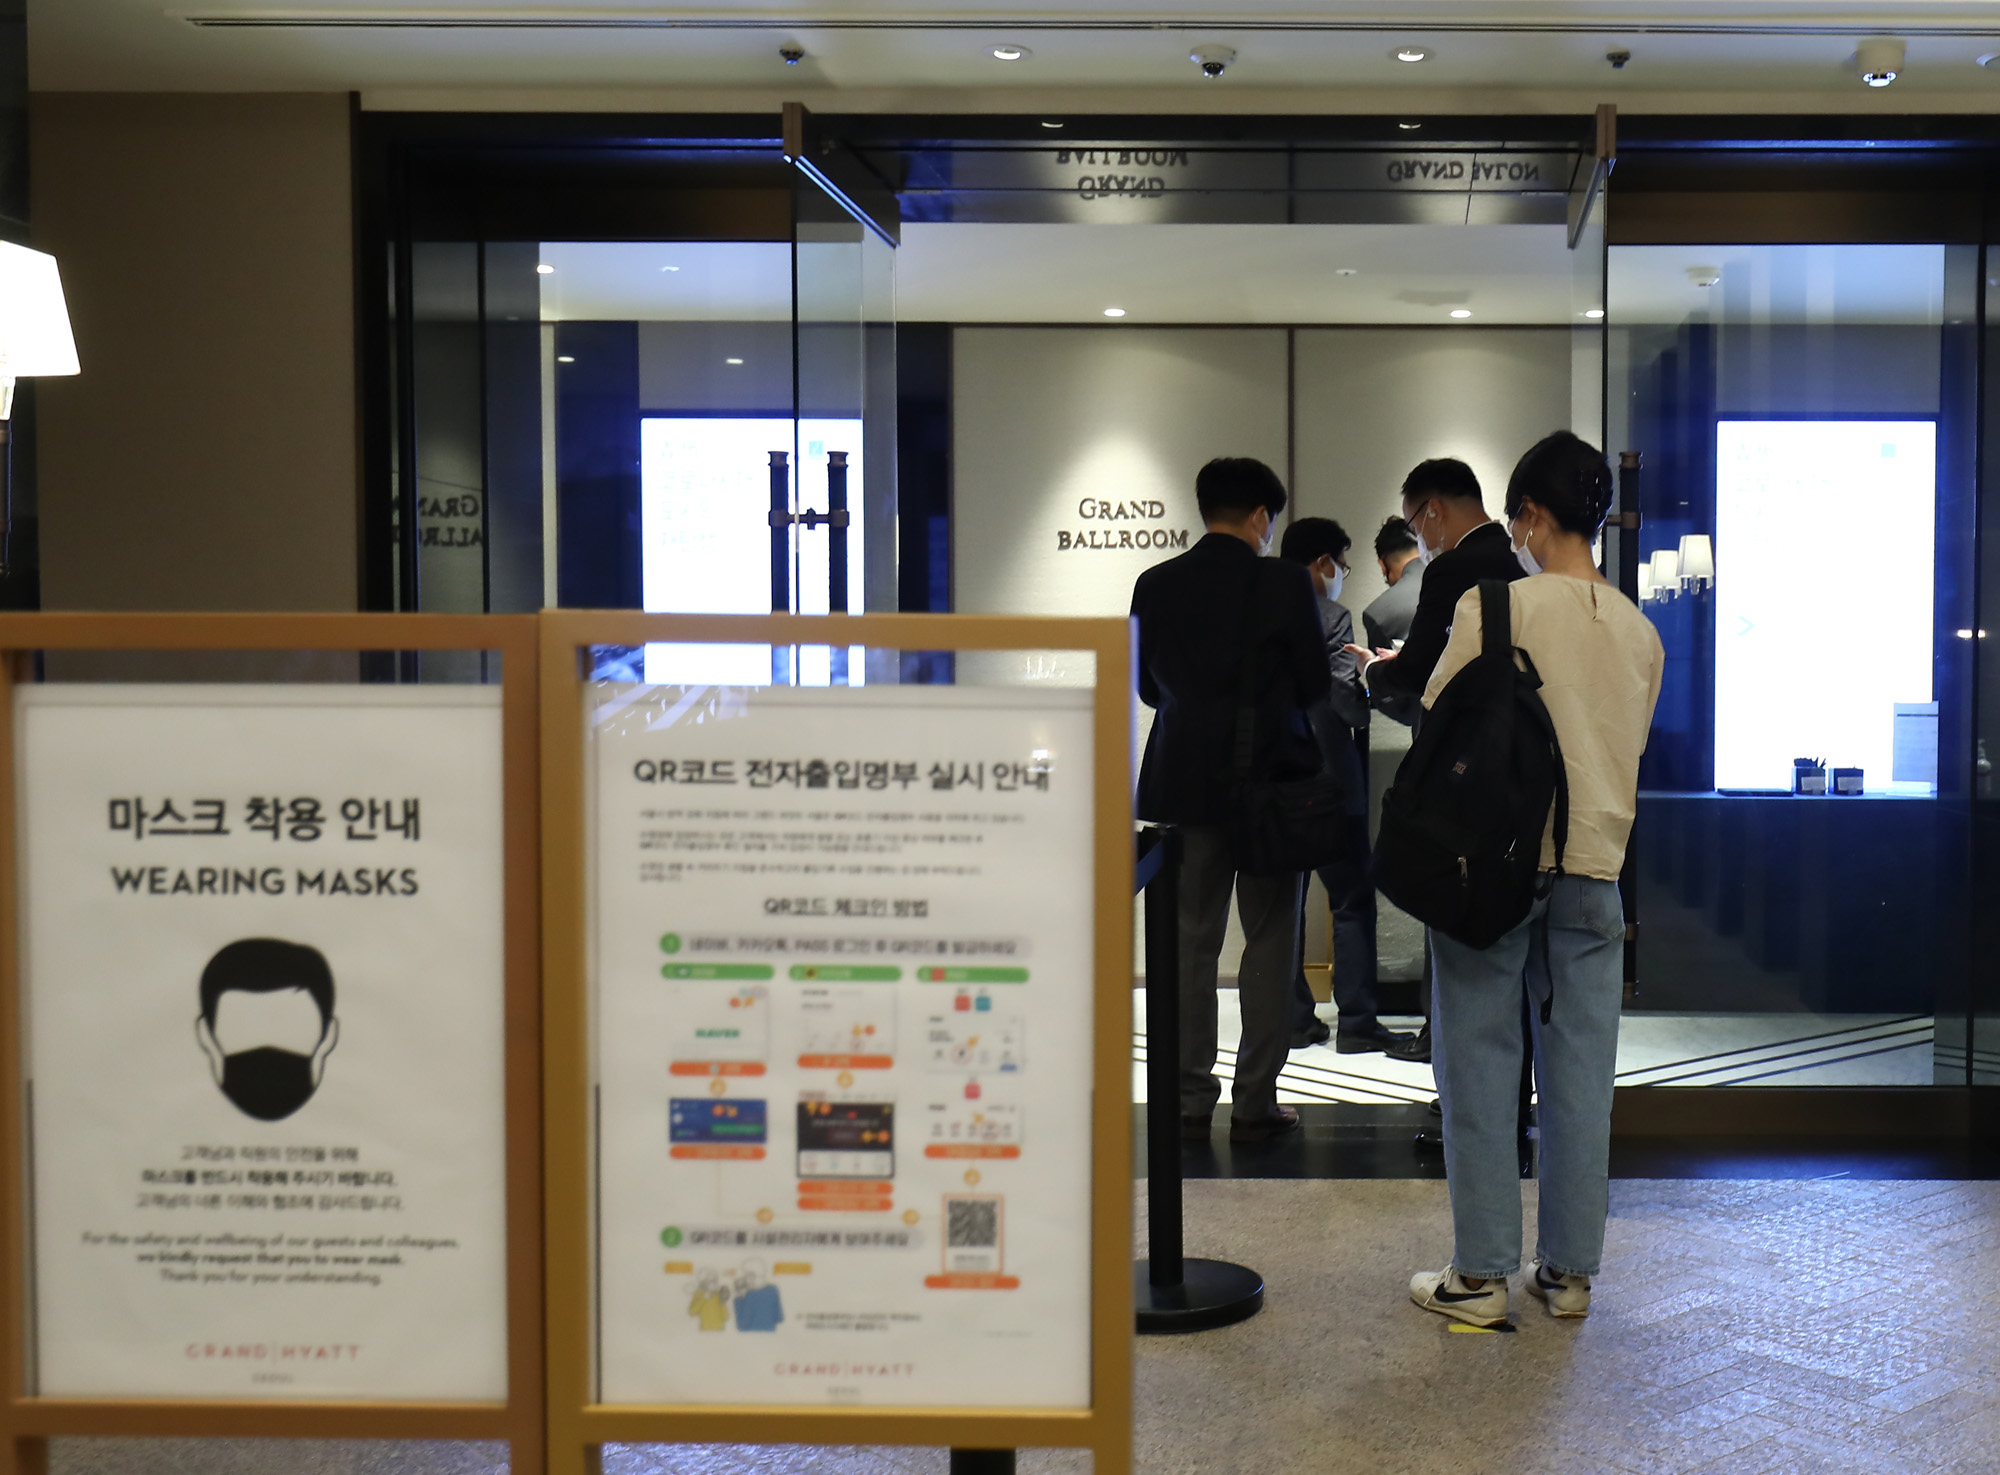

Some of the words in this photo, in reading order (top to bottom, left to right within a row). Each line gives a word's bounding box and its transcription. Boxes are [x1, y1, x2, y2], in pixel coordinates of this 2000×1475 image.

[1079, 497, 1166, 520] GRAND
[1057, 529, 1189, 550] BALLROOM
[634, 760, 738, 788] QR코드
[745, 760, 920, 790] 전자출입명부
[927, 762, 985, 790] 실시
[992, 763, 1050, 792] 안내
[108, 797, 230, 841] 마스크
[244, 797, 326, 841] 착용
[341, 797, 421, 841] 안내
[112, 867, 285, 895] WEARING
[298, 867, 420, 896] MASKS
[764, 898, 828, 917] QR코드
[835, 898, 888, 917] 체크인
[185, 1343, 269, 1360] GRAND
[281, 1344, 360, 1361] HYATT
